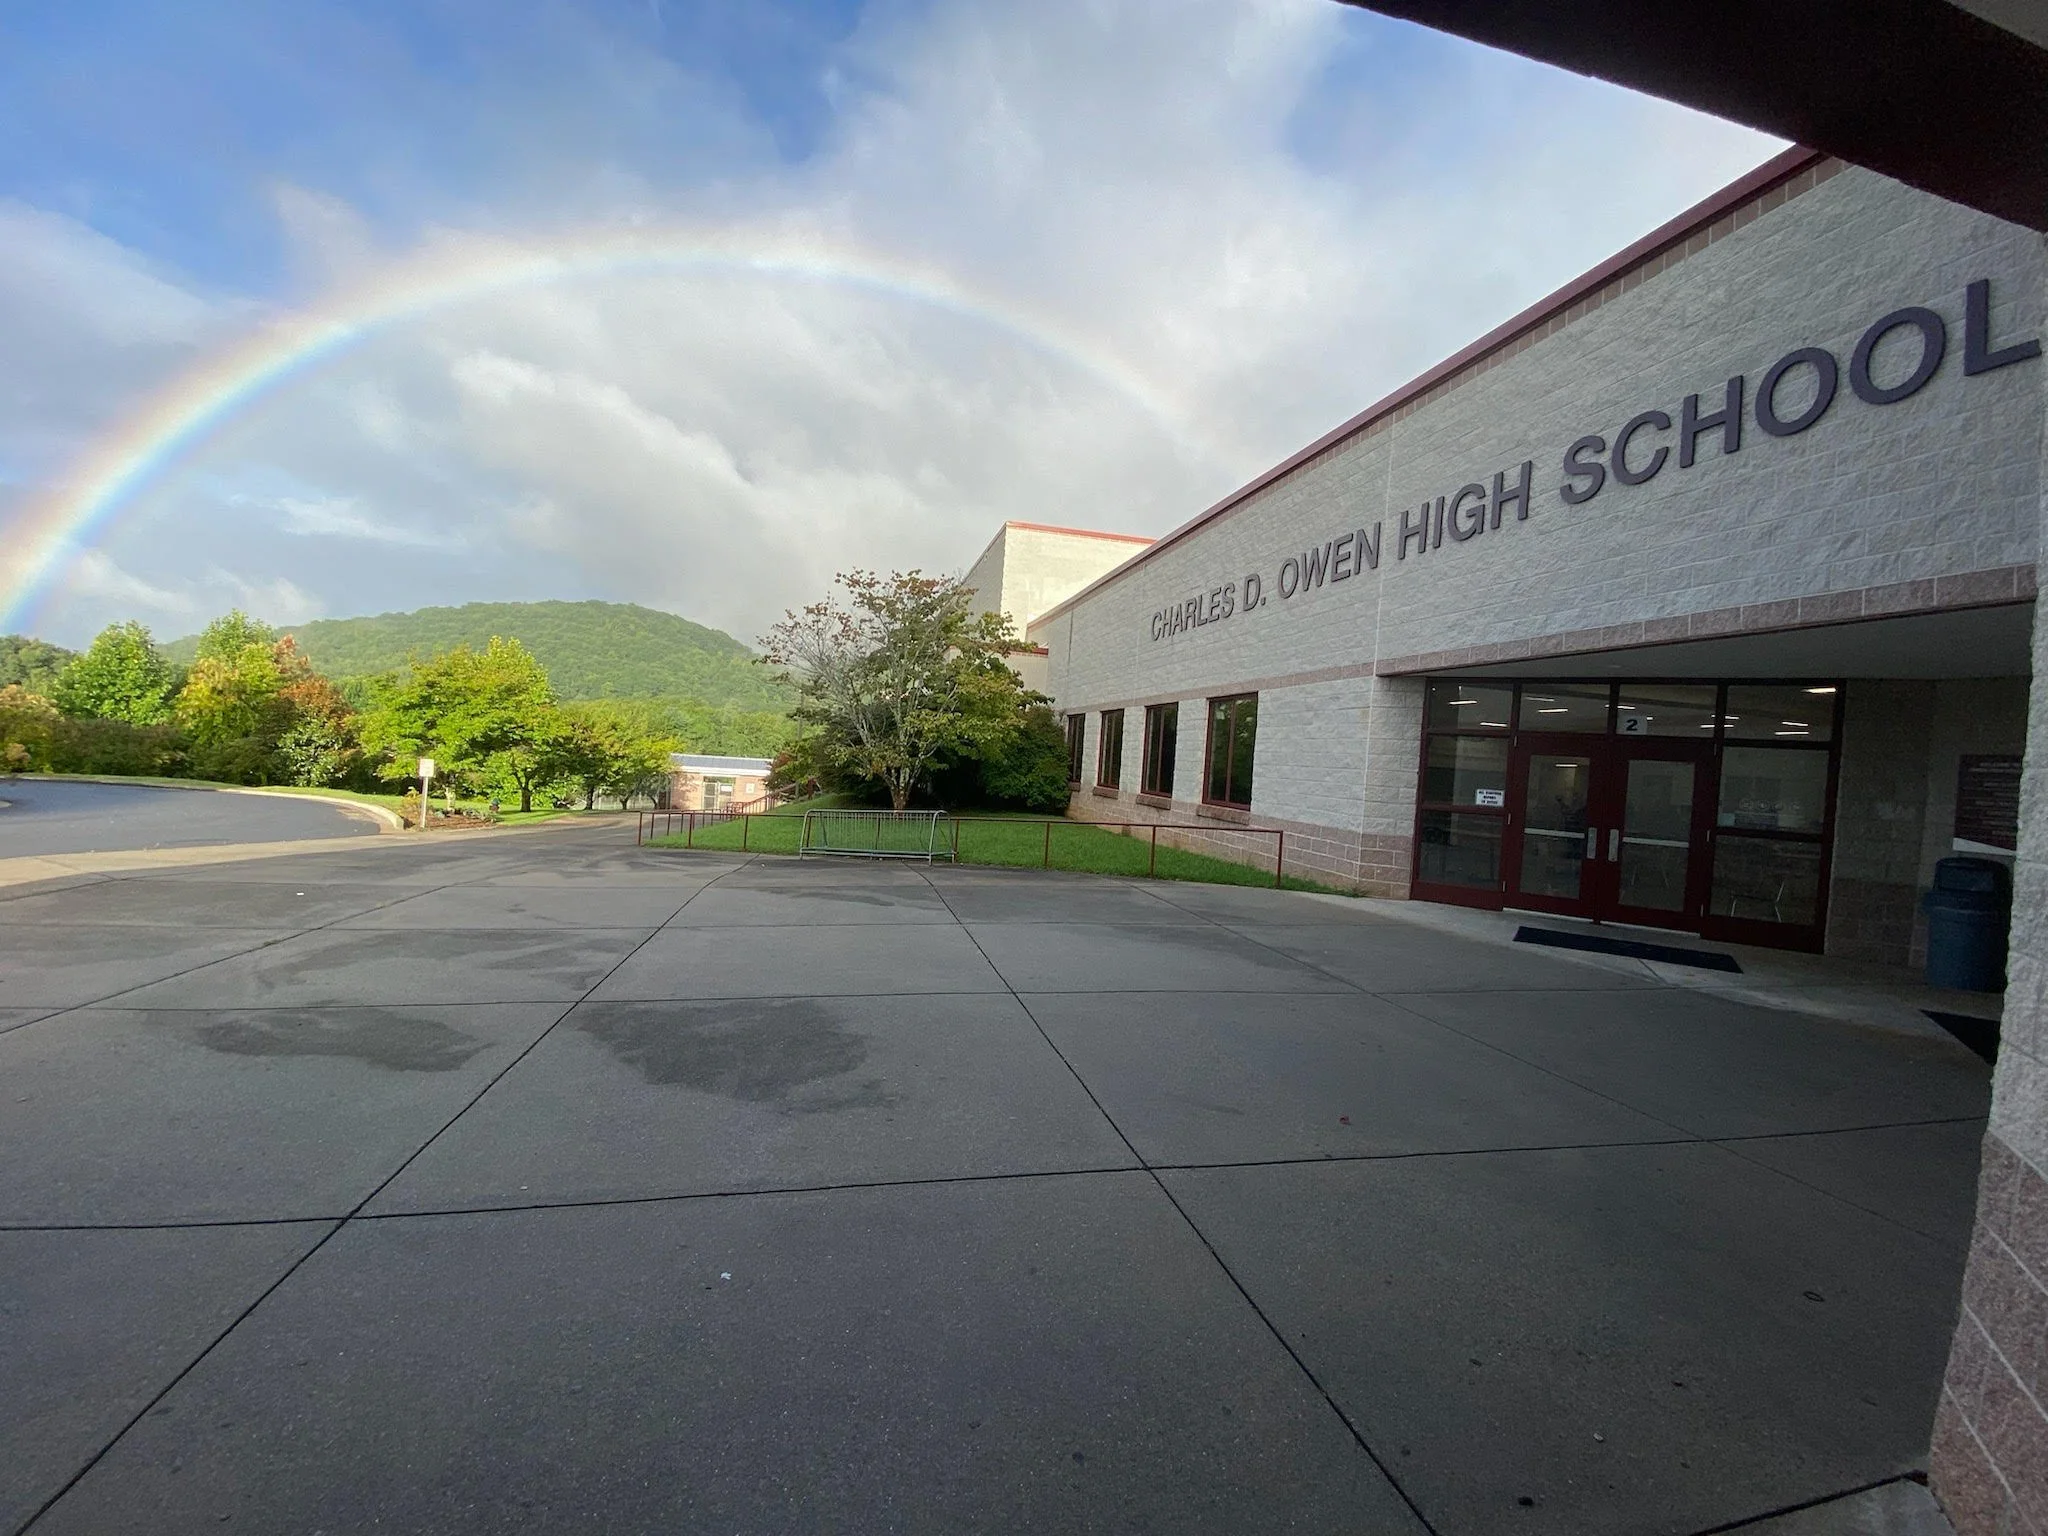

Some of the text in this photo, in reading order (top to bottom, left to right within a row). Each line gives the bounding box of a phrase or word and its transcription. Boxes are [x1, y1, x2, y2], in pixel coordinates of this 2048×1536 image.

[1152, 279, 2043, 642] CHARLES D. OWEN HIGH SCHOOL
[1626, 719, 1638, 731] 2
